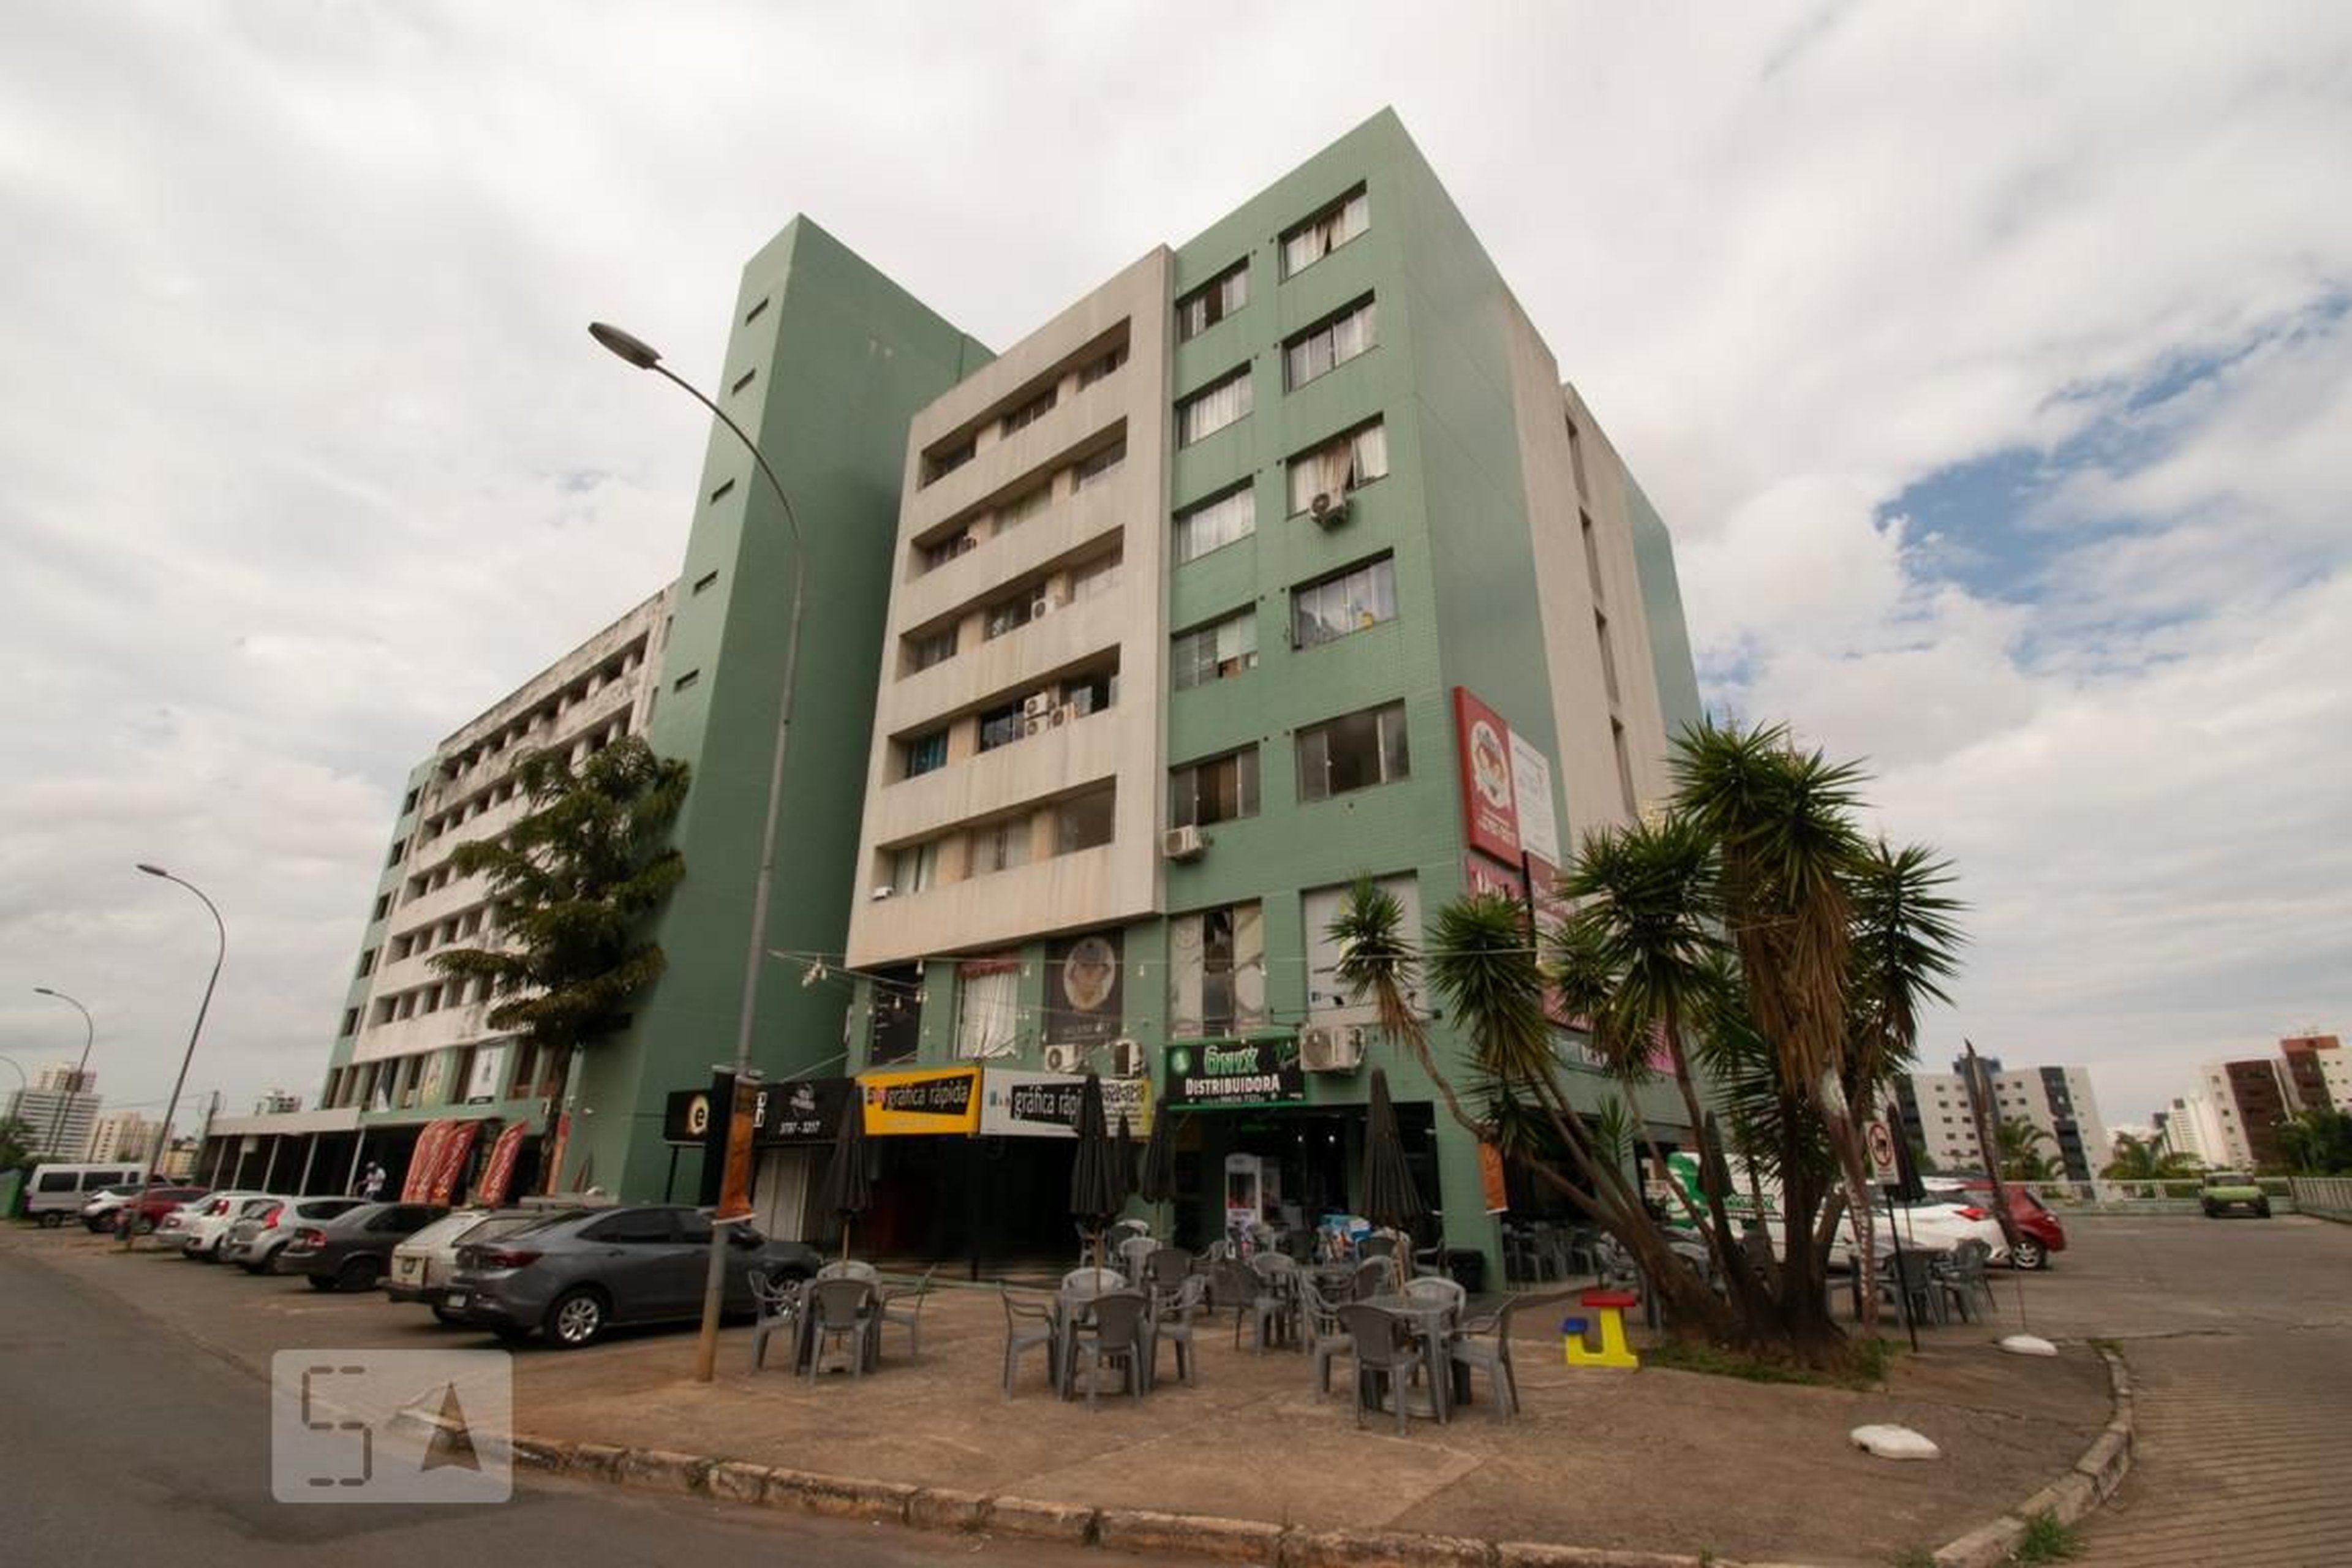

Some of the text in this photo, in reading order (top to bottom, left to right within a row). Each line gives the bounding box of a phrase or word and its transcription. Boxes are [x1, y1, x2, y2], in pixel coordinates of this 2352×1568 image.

[930, 1078, 968, 1109] rápida
[1014, 1085, 1056, 1120] gráfica
[1058, 1087, 1082, 1122] rápi
